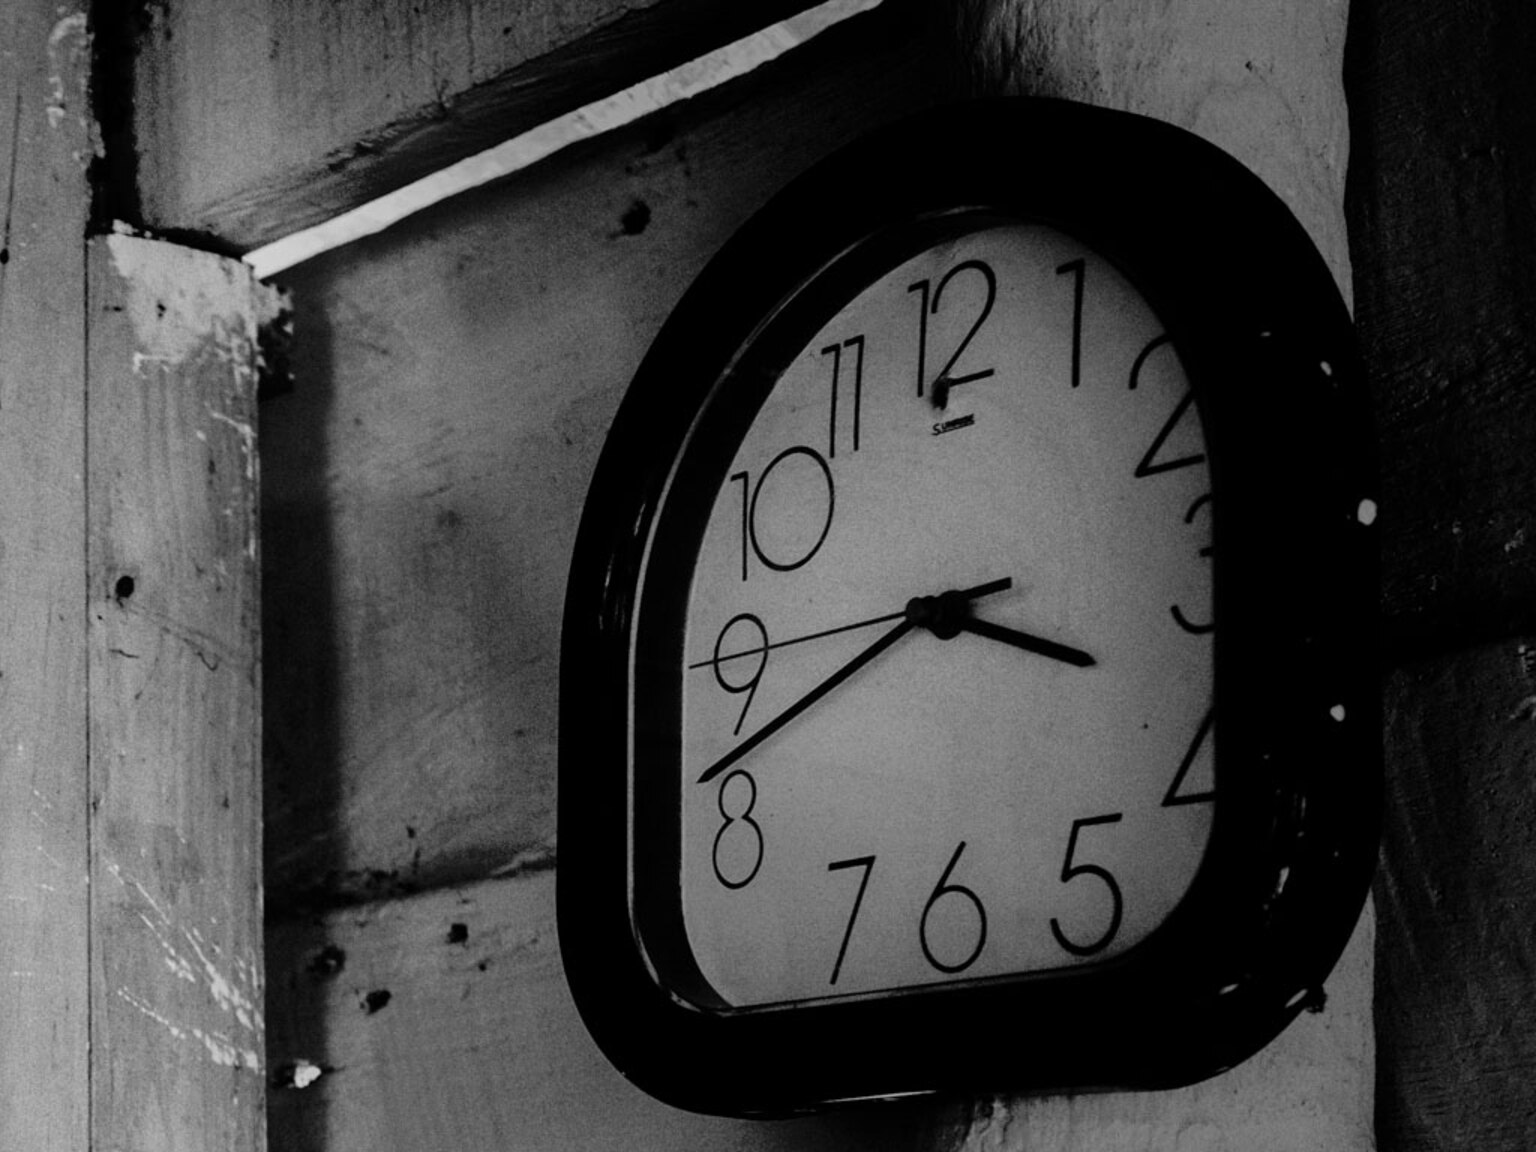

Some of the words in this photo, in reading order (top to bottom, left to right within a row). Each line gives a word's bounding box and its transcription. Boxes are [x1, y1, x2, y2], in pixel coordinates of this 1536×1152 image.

[907, 259, 997, 398] 12
[1056, 258, 1086, 389] 1
[821, 334, 866, 459] 11
[730, 446, 834, 581] 10
[713, 613, 769, 736] 9
[713, 769, 764, 889] 8
[1050, 812, 1123, 956] 5
[828, 856, 876, 985] 7
[919, 841, 987, 974] 6
